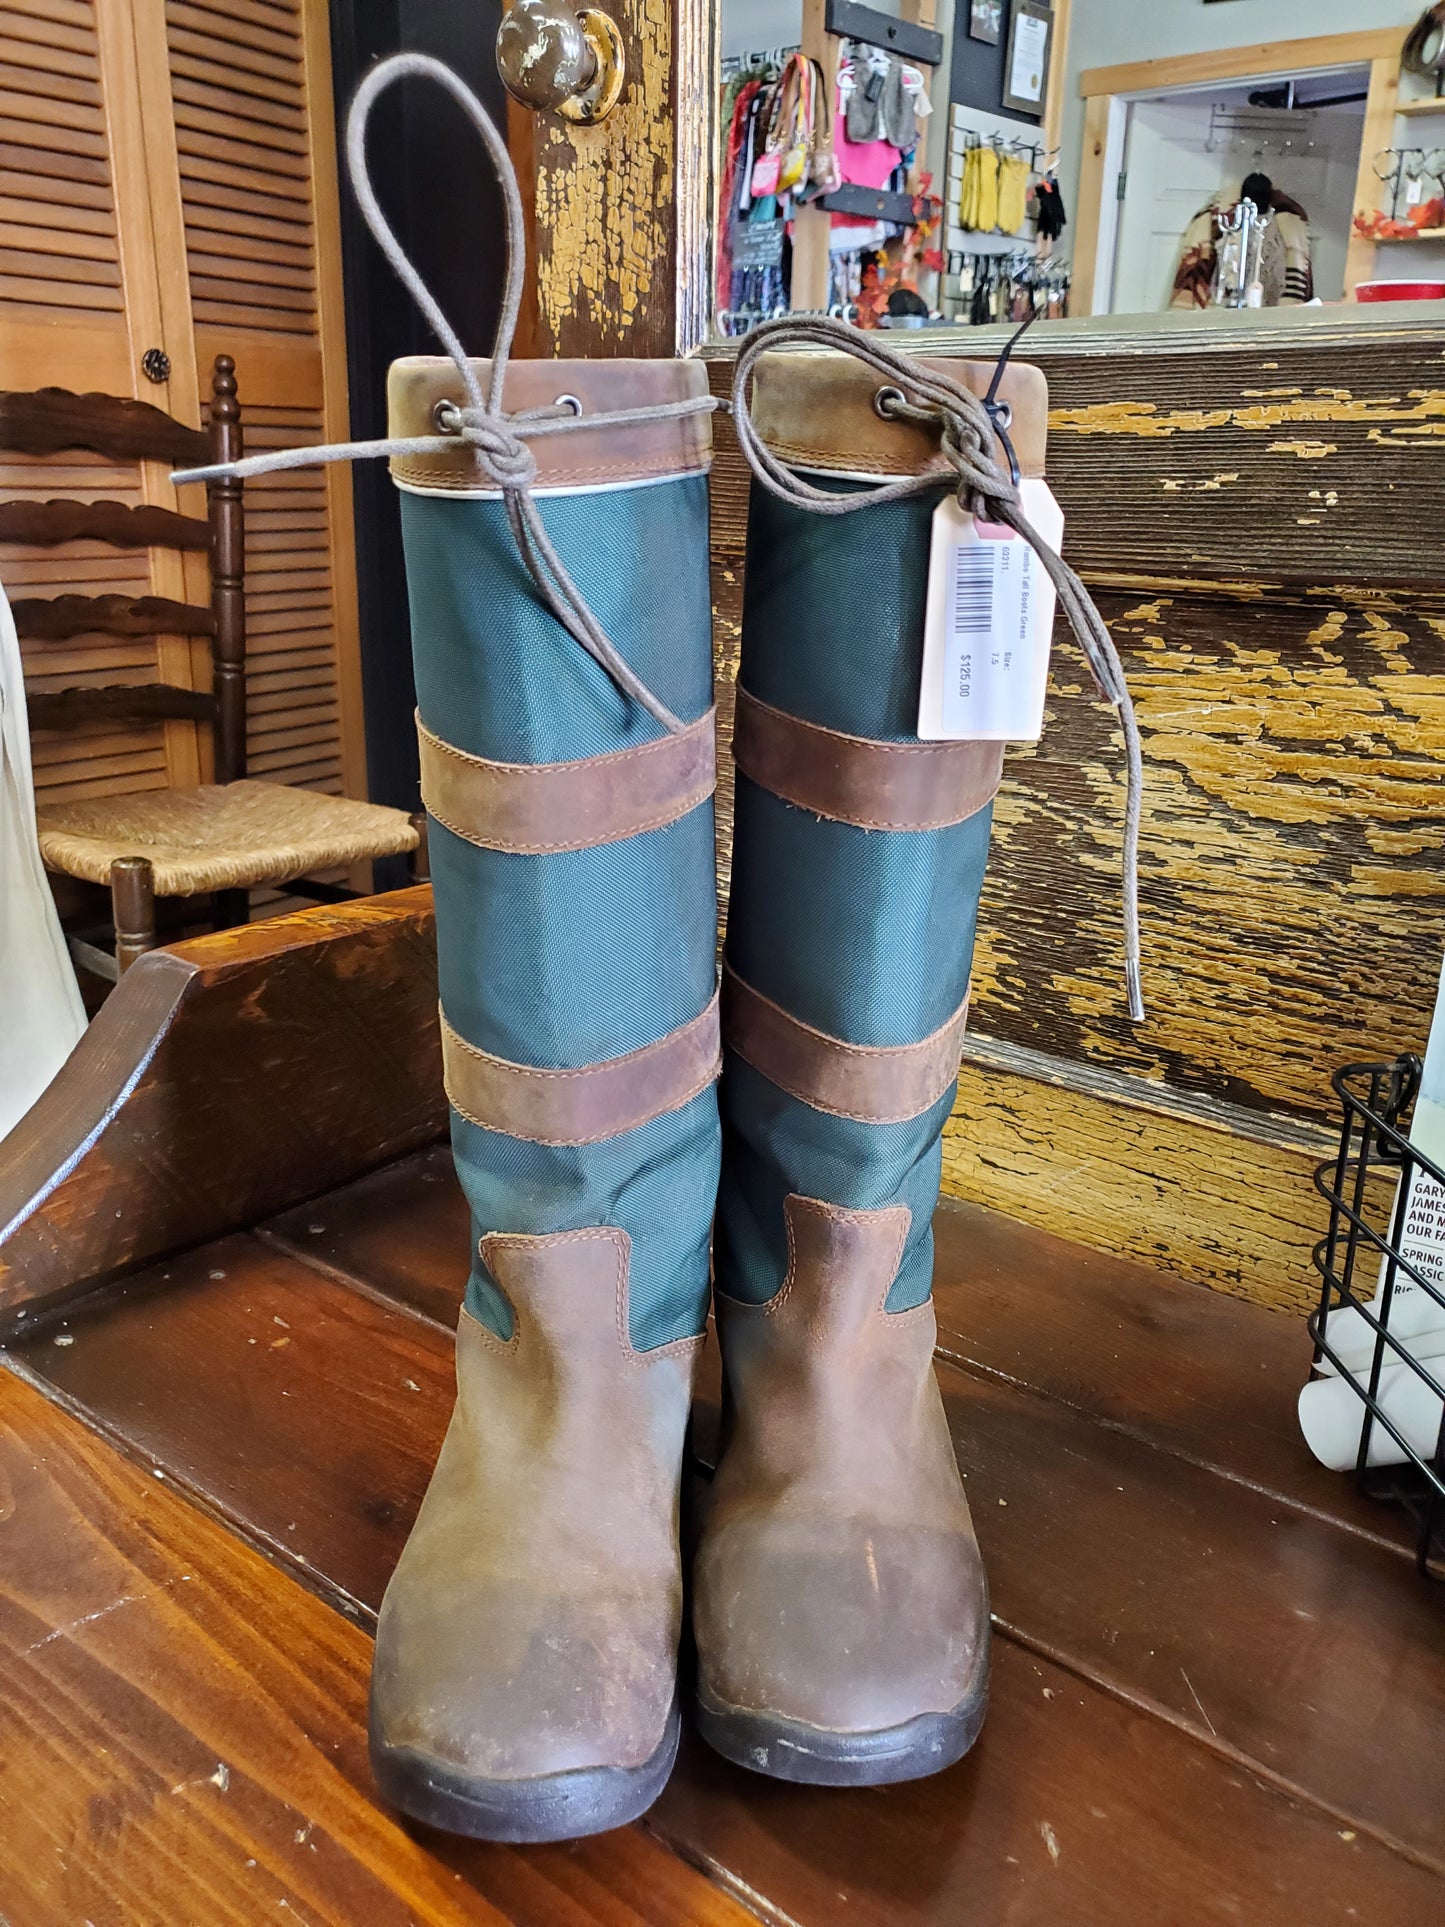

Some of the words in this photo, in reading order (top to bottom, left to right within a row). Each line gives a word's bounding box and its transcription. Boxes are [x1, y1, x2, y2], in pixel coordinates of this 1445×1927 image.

[1022, 545, 1032, 573] Rambo
[1022, 576, 1031, 589] Tall
[1020, 592, 1030, 614] Boots
[1019, 616, 1029, 639] Green
[959, 654, 972, 697] $125.00
[1408, 1209, 1434, 1224] AND
[1406, 1223, 1432, 1239] OUR
[1401, 1247, 1443, 1267] SPRING
